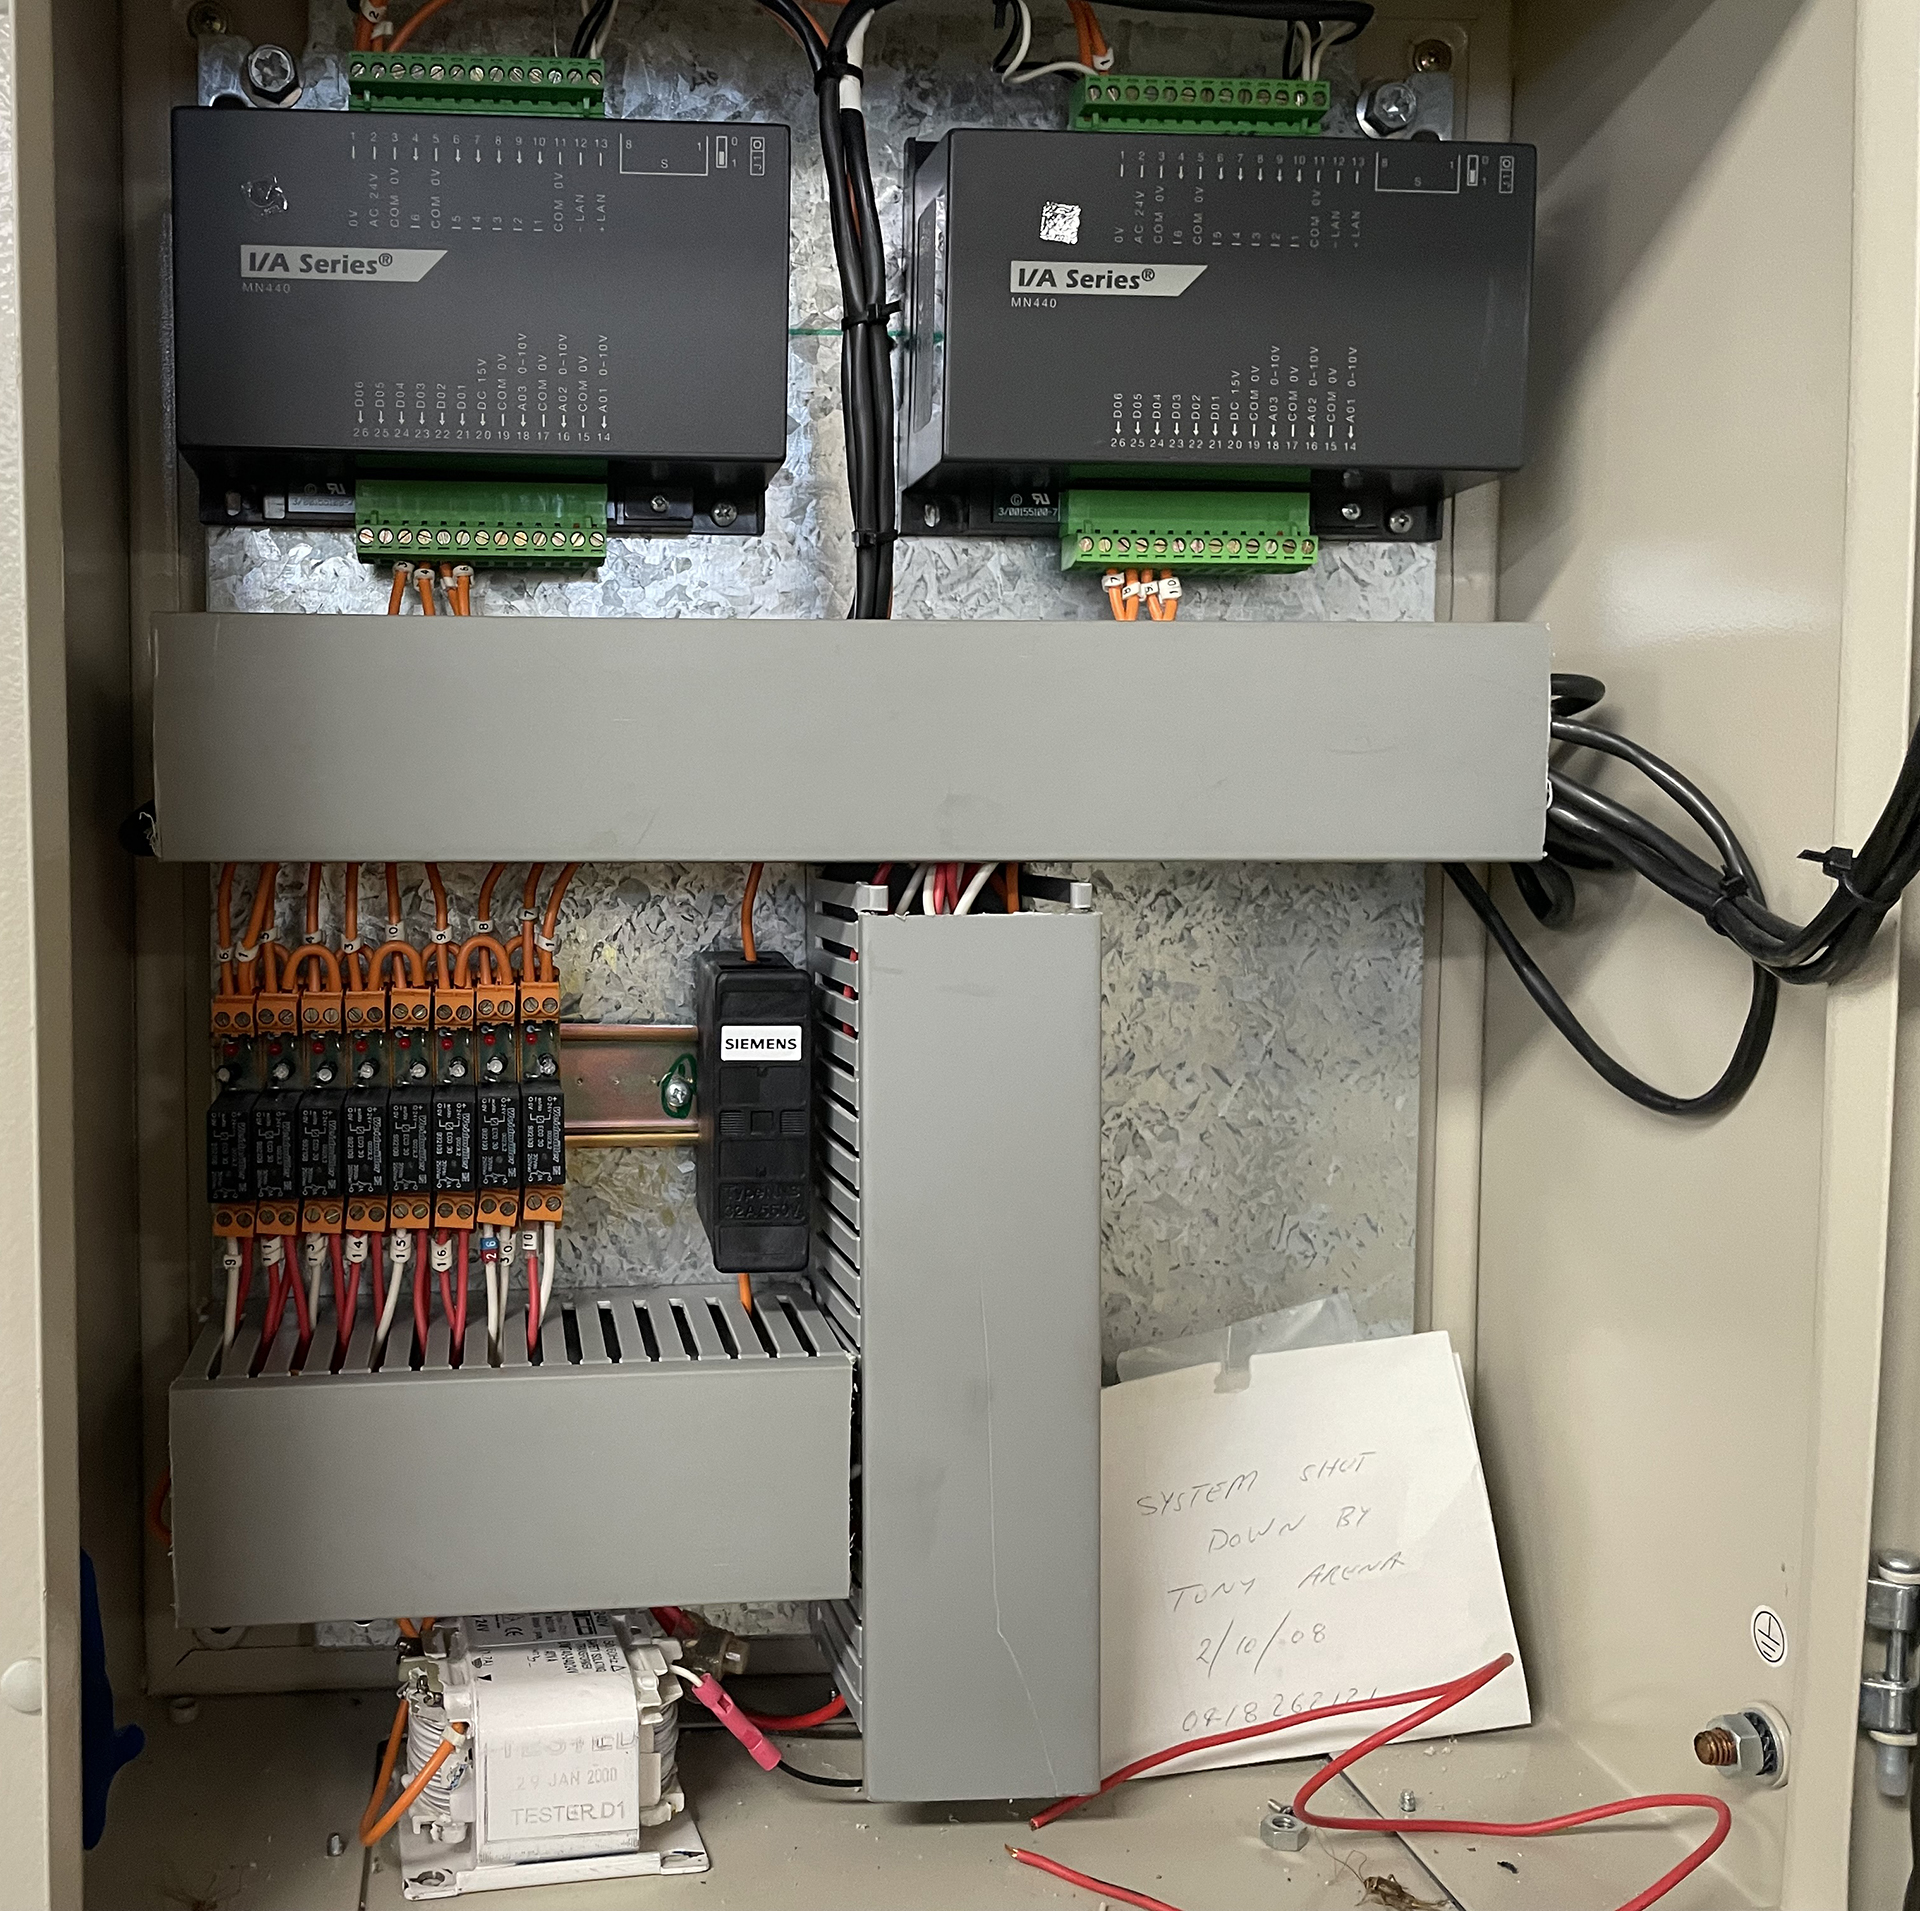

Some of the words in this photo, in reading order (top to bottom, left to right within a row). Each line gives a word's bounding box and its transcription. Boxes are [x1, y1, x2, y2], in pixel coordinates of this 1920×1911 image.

[371, 132, 377, 142] 2
[392, 133, 398, 142] 3
[413, 134, 418, 142] 4
[433, 135, 439, 143] 5
[454, 135, 459, 144] 6
[475, 135, 480, 144] 7
[496, 136, 501, 145] 8
[516, 137, 522, 145] 9
[534, 137, 545, 146] 10
[555, 138, 565, 146] 11
[575, 139, 587, 147] 12
[595, 139, 607, 148] 13
[626, 140, 632, 149] 8
[661, 159, 668, 168] S
[249, 252, 289, 272] I/A
[1019, 268, 1056, 287] I/A
[243, 283, 290, 293] MN440
[1012, 297, 1056, 308] MN440
[354, 428, 369, 437] 26
[375, 428, 389, 437] 25
[395, 429, 409, 437] 24
[415, 429, 429, 438] 23
[435, 430, 450, 439] 22
[457, 430, 469, 439] 21
[476, 431, 491, 439] 20
[498, 431, 509, 440] 19
[518, 431, 529, 440] 18
[538, 432, 549, 440] 17
[558, 432, 569, 441] 16
[578, 433, 590, 441] 15
[598, 433, 609, 441] 14
[1111, 438, 1125, 447] 26
[1131, 438, 1144, 447] 25
[1150, 439, 1163, 447] 24
[1169, 439, 1183, 448] 23
[1189, 439, 1203, 448] 22
[1209, 440, 1221, 449] 21
[1228, 440, 1242, 449] 20
[1249, 441, 1260, 449] 19
[1267, 441, 1279, 450] 18
[1287, 441, 1298, 449] 17
[1306, 442, 1317, 450] 16
[1325, 442, 1337, 451] 15
[1345, 443, 1356, 451] 14
[726, 1038, 797, 1049] SIEMENS
[524, 1234, 533, 1247] 10
[353, 1240, 363, 1258] 14
[397, 1239, 405, 1259] 15
[1136, 1470, 1259, 1516] SYSTEM
[1207, 1514, 1306, 1553] DOWN
[1336, 1506, 1371, 1528] BY
[1167, 1578, 1256, 1611] TONY
[1195, 1610, 1326, 1678] 2/10/08
[549, 1771, 580, 1787] JAN
